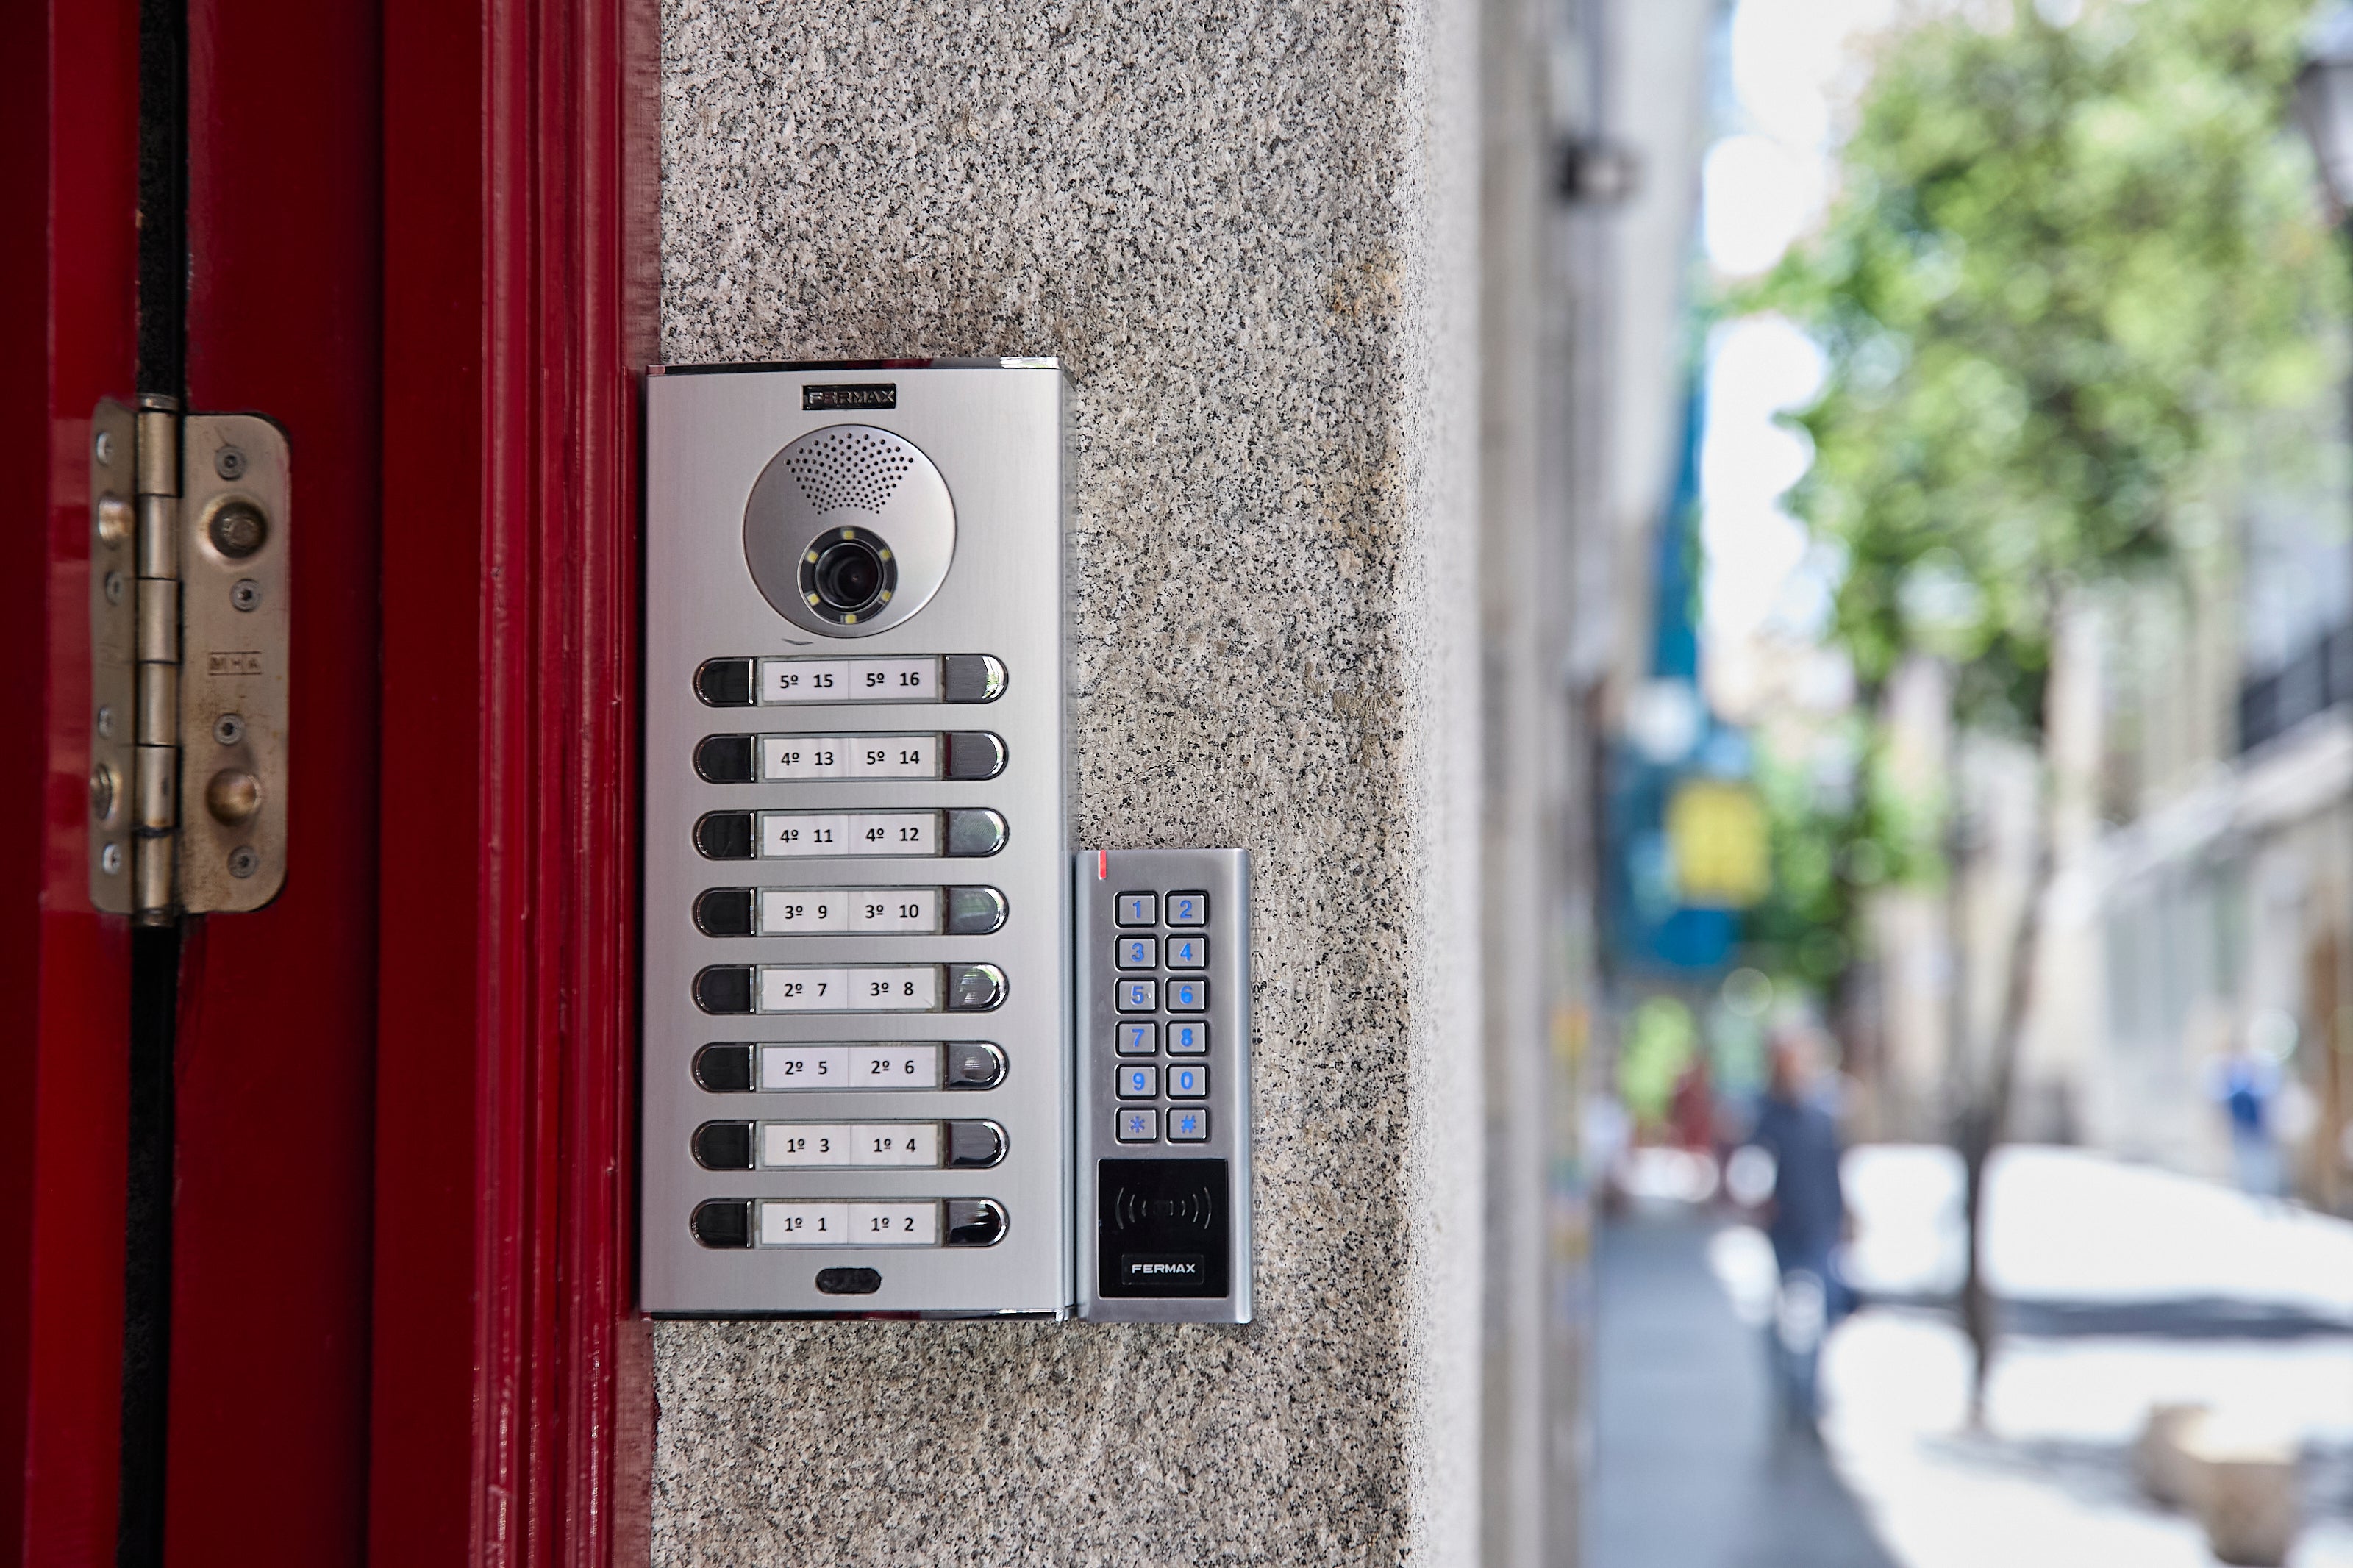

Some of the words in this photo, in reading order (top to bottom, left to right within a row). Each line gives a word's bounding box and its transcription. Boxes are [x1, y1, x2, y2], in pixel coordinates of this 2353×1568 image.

[808, 390, 895, 404] FERMAX
[813, 673, 834, 689] 15
[899, 671, 920, 687] 16
[814, 751, 834, 766] 13
[899, 750, 920, 765] 14
[813, 828, 833, 843] 11
[899, 827, 920, 842] 12
[818, 905, 828, 920] 9
[899, 903, 919, 919] 10
[1132, 900, 1141, 918] 1
[1179, 900, 1193, 919] 2
[1131, 942, 1145, 962] 3
[1179, 942, 1193, 962] 4
[817, 983, 827, 997] 7
[903, 981, 914, 996] 8
[1131, 985, 1144, 1005] 5
[1179, 985, 1193, 1005] 6
[1131, 1028, 1145, 1048] 7
[1180, 1028, 1193, 1048] 8
[818, 1060, 828, 1075] 5
[904, 1059, 915, 1075] 6
[1132, 1072, 1146, 1091] 9
[1179, 1071, 1194, 1090] 0
[819, 1138, 829, 1153] 3
[905, 1138, 916, 1153] 4
[818, 1217, 826, 1231] 1
[904, 1217, 914, 1232] 2
[1132, 1263, 1196, 1274] FERMAX
